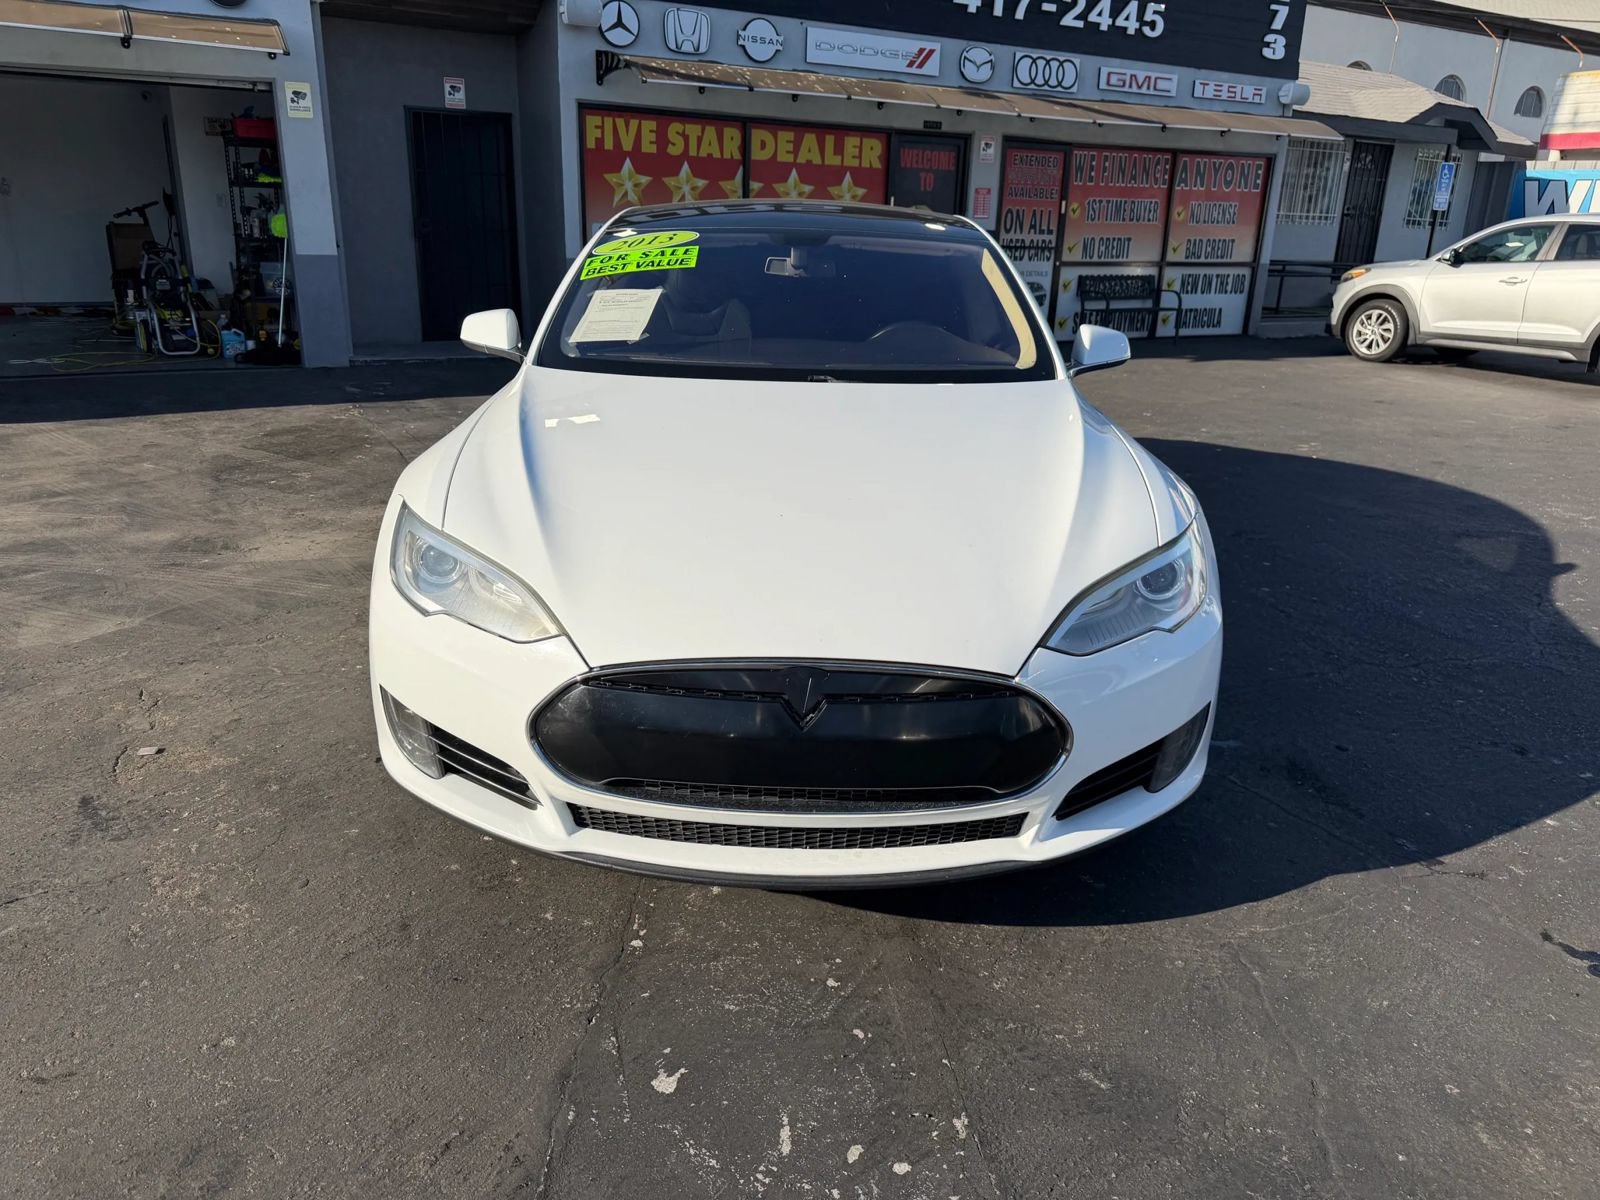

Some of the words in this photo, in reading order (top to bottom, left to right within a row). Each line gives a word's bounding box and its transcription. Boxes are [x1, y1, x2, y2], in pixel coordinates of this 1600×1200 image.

[738, 33, 783, 47] NISSAN
[815, 41, 919, 61] DODGE
[1106, 71, 1173, 93] GMC
[1199, 81, 1263, 102] TESLA
[585, 115, 657, 154] FIVE
[666, 122, 743, 160] STAR
[751, 128, 882, 169] DEALER
[900, 147, 956, 171] WELCOME
[1013, 153, 1059, 169] EXTENDED
[919, 171, 935, 192] TO
[1073, 151, 1097, 185] WE
[1099, 152, 1171, 189] FINANCE
[1175, 157, 1265, 192] ANYONE
[1007, 186, 1058, 200] AVAILABLE!
[1003, 207, 1025, 235] ON
[1027, 208, 1054, 236] ALL
[1086, 198, 1104, 223] 1ST
[1104, 198, 1128, 224] TIME
[1128, 199, 1160, 225] BUYER
[1188, 201, 1202, 225] NO
[1203, 202, 1239, 225] LICENSE
[586, 253, 630, 267] FOR
[639, 247, 695, 259] SALE
[1001, 238, 1026, 261] USED
[1027, 238, 1053, 262] CARS
[1081, 236, 1096, 260] NO
[1097, 236, 1133, 260] CREDIT
[1184, 237, 1203, 260] BAD
[1204, 237, 1236, 260] CREDIT
[584, 262, 630, 277] BEST
[635, 257, 692, 269] VALUE
[1180, 272, 1201, 295] NEW
[1201, 272, 1213, 295] ON
[1214, 273, 1229, 295] THE
[1229, 273, 1246, 295] JOB
